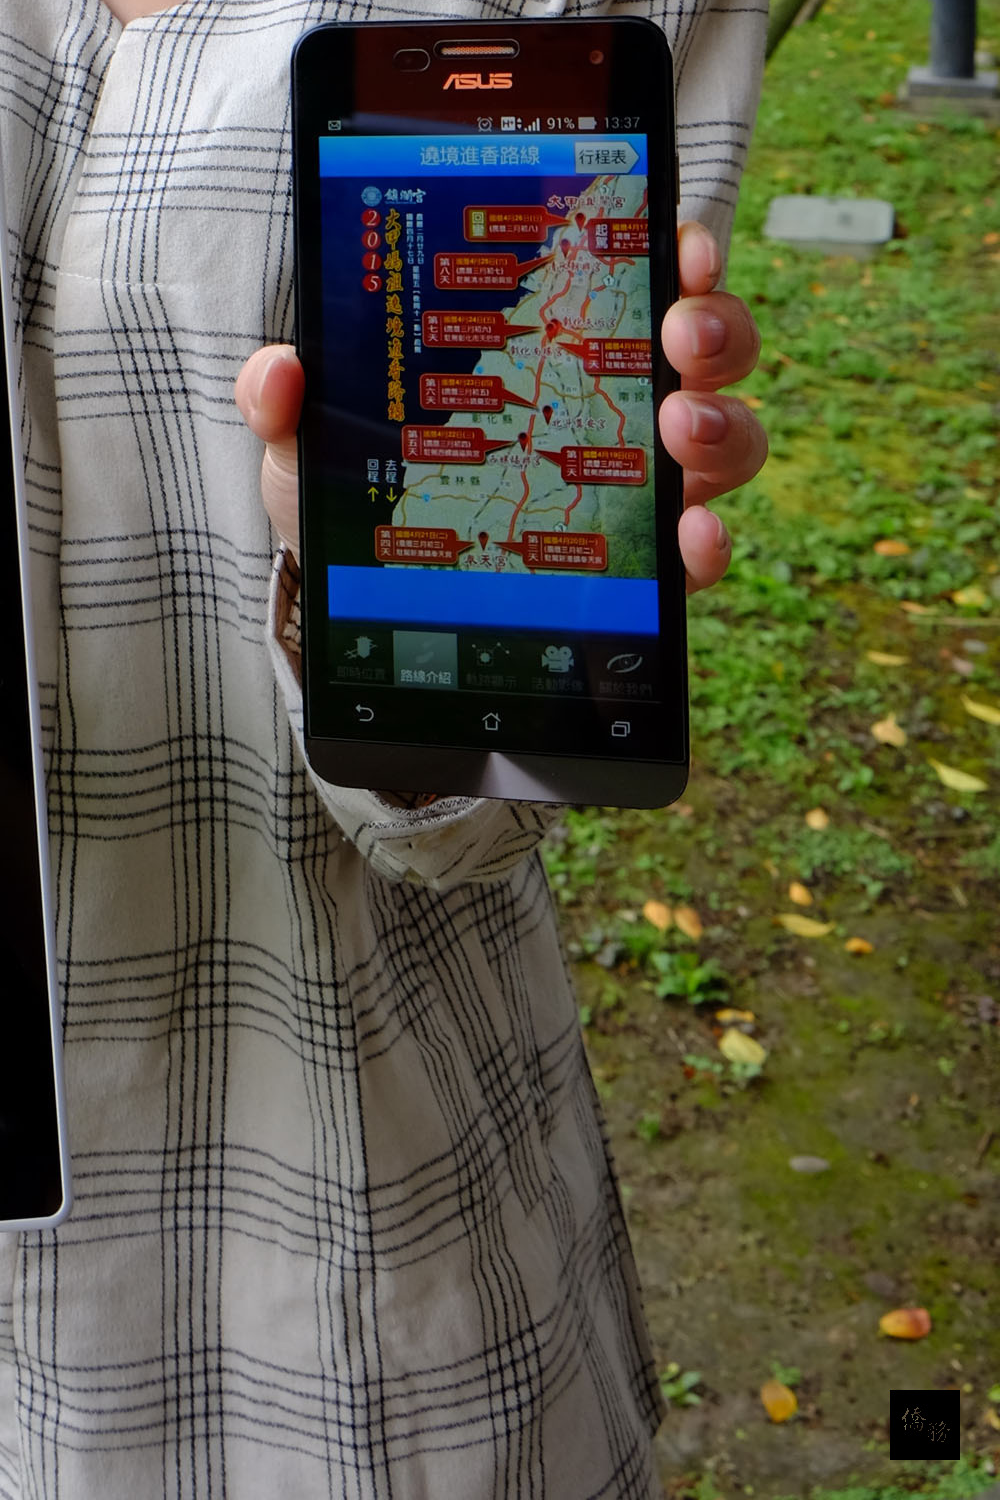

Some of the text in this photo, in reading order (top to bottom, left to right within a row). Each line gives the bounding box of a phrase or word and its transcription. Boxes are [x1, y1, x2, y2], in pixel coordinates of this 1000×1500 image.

[442, 72, 513, 90] ASUS
[547, 116, 641, 130] 91% 13:37
[578, 149, 627, 164] 行程表
[367, 458, 380, 483] 回程
[385, 460, 398, 484] 去程
[566, 450, 578, 477] 第二天
[400, 668, 452, 686] 路線介紹
